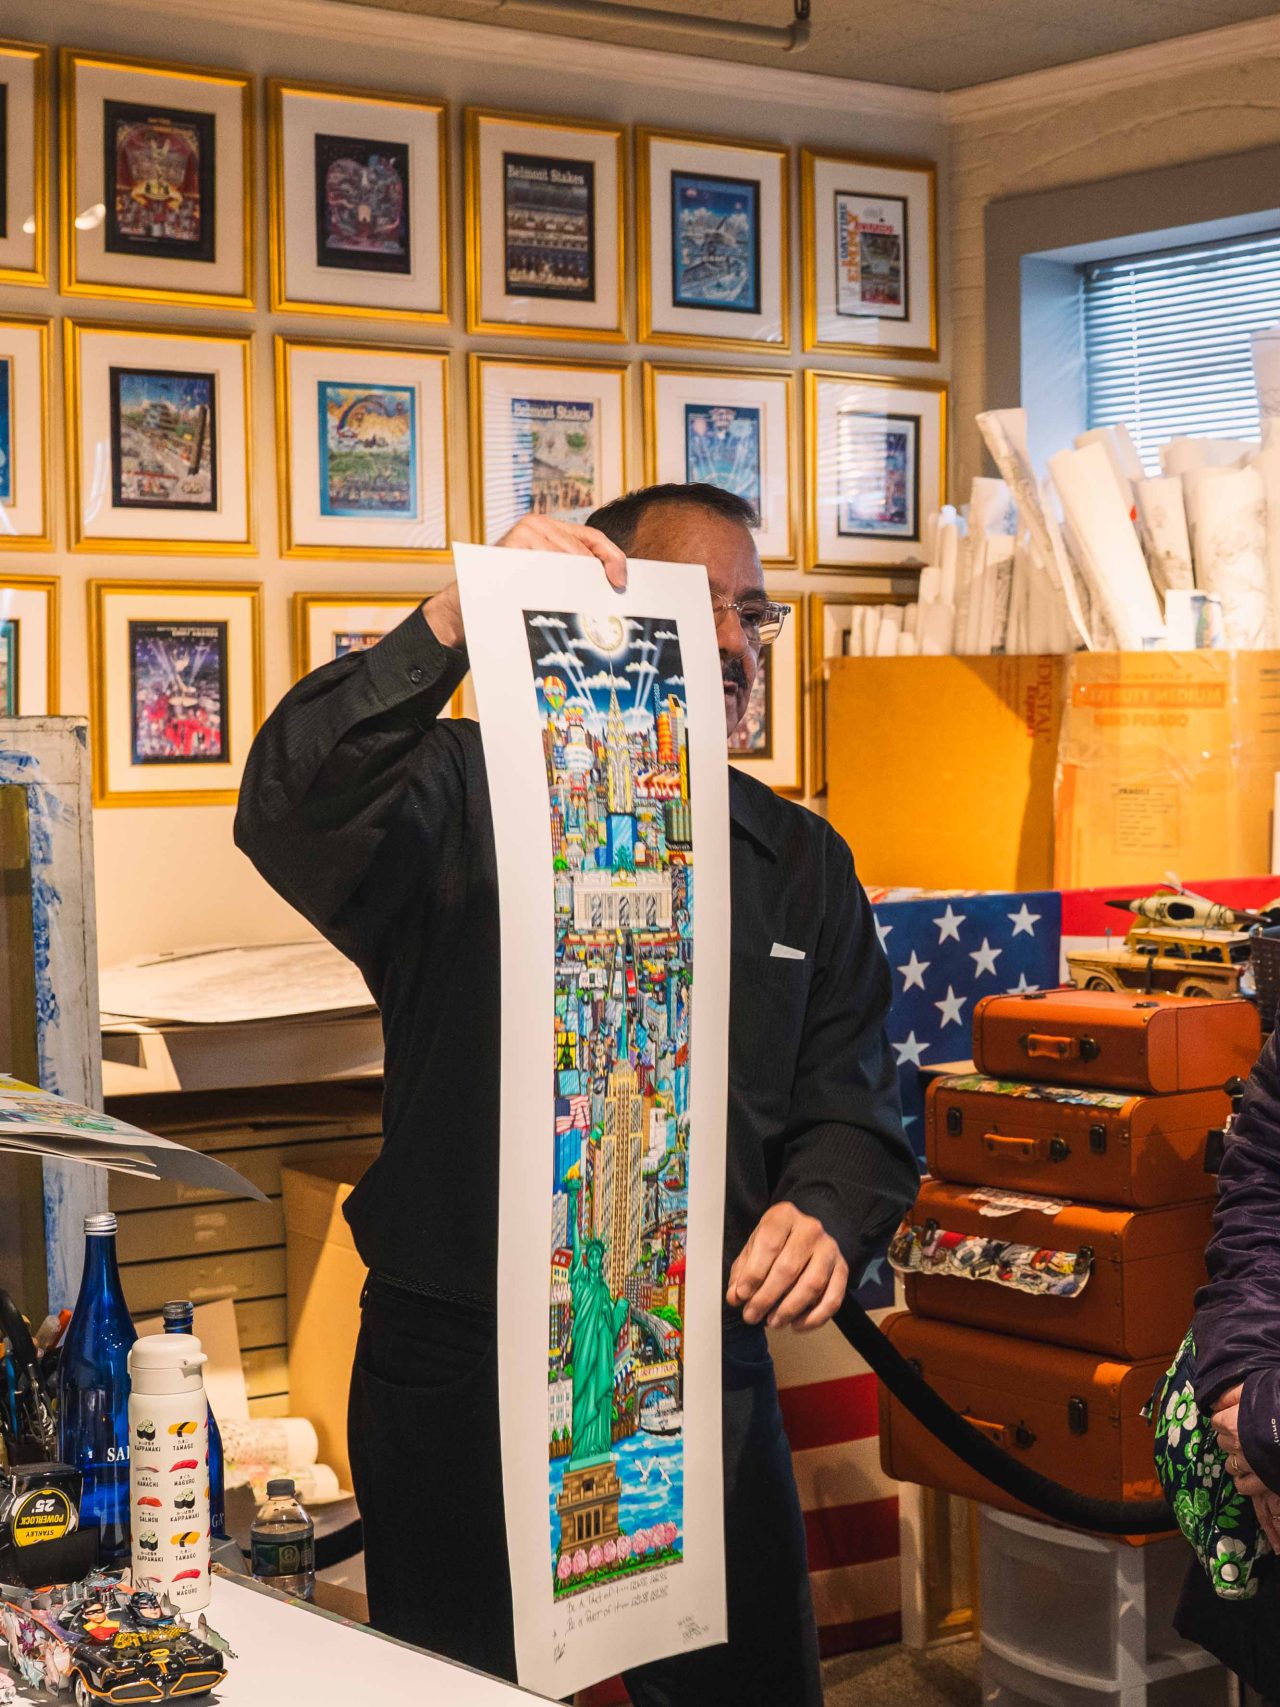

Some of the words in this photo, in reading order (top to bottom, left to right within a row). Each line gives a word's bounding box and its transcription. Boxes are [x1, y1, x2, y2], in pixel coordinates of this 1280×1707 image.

[507, 164, 548, 181] Belmont
[550, 169, 585, 185] Stakes
[556, 404, 592, 421] Stakes
[21, 1513, 65, 1525] POWERLOCK
[170, 1513, 200, 1522] KAPPAMAKI
[26, 1530, 54, 1538] STANLEY
[137, 1555, 164, 1563] KAPPAMAKI
[175, 1553, 197, 1561] TAMAGO
[176, 1588, 198, 1596] MAGURO
